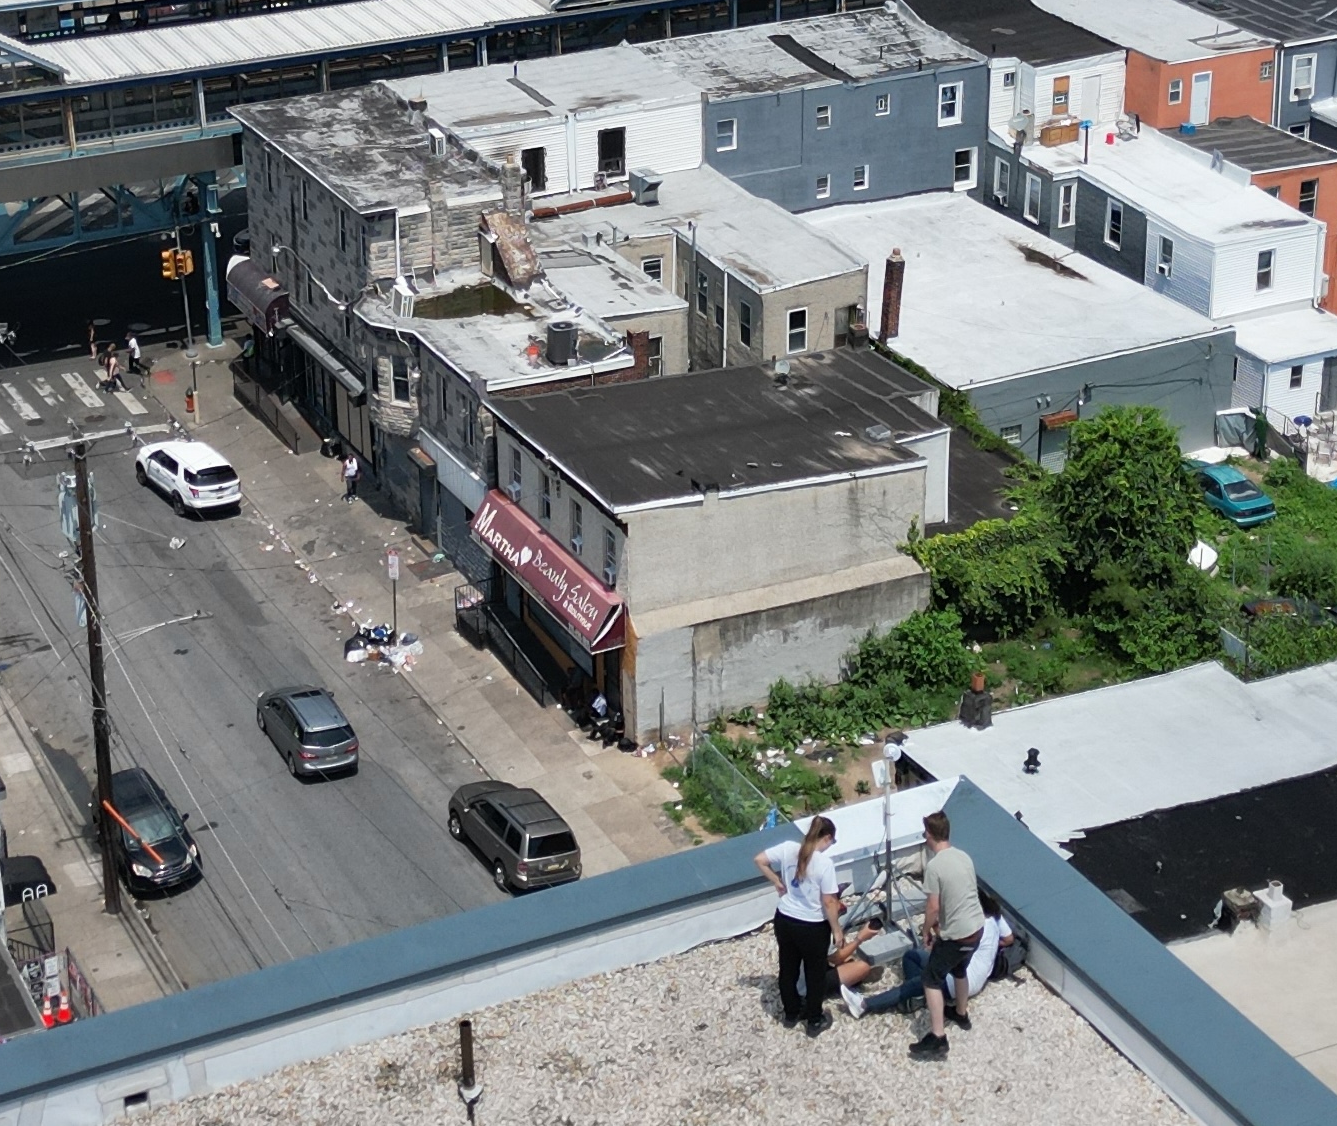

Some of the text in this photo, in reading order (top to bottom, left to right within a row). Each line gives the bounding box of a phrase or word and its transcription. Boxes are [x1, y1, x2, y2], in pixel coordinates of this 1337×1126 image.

[474, 502, 520, 567] MARTHA
[532, 548, 569, 602] Beauty
[566, 584, 599, 621] Salon
